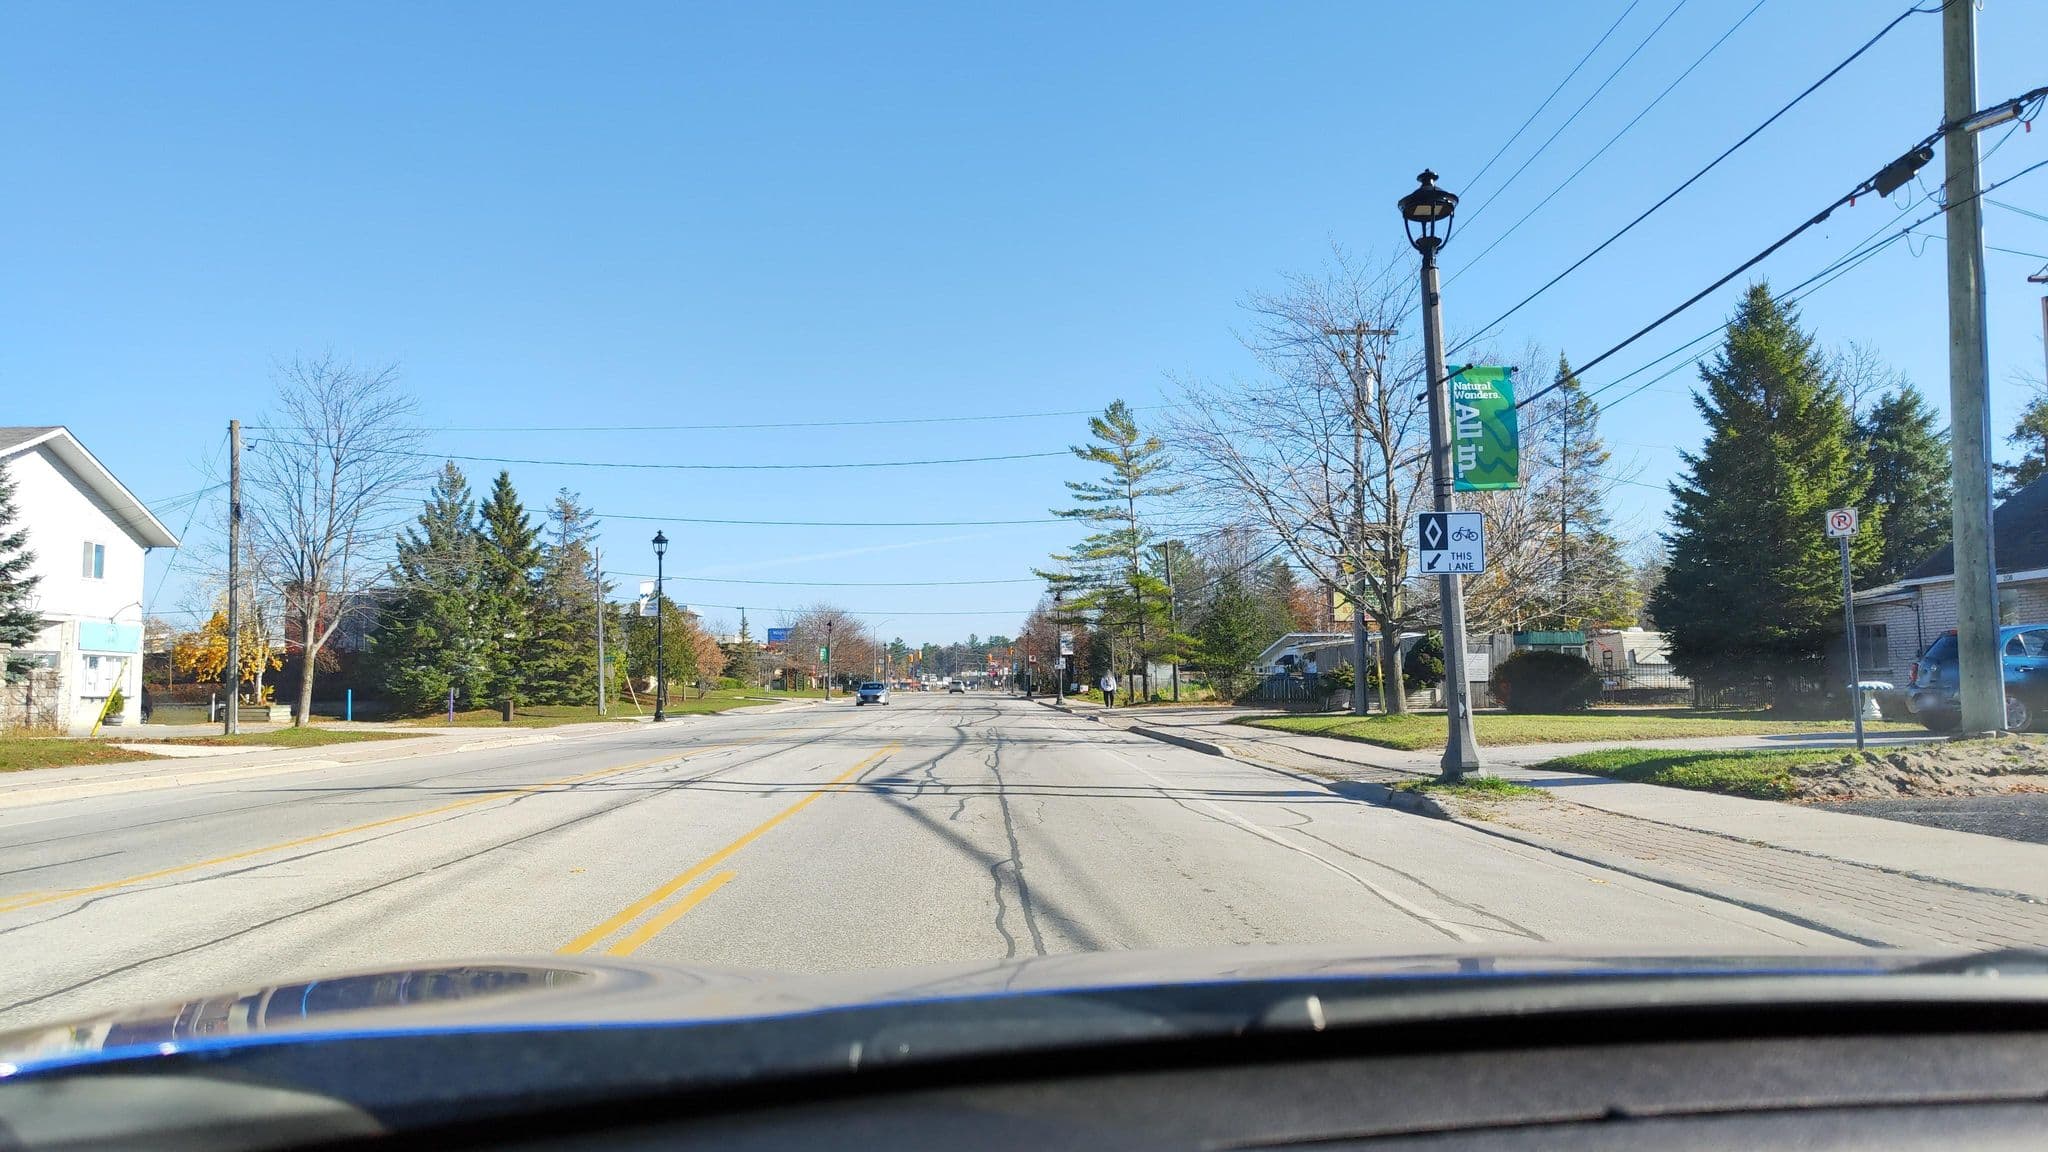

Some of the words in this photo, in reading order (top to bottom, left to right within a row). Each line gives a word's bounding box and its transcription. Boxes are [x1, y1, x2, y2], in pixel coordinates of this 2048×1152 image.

[1454, 382, 1491, 391] Natural
[1454, 391, 1502, 399] Wonders.
[1456, 402, 1483, 440] All
[1458, 444, 1483, 478] in.
[1451, 552, 1472, 561] THIS
[1448, 562, 1474, 571] LANE
